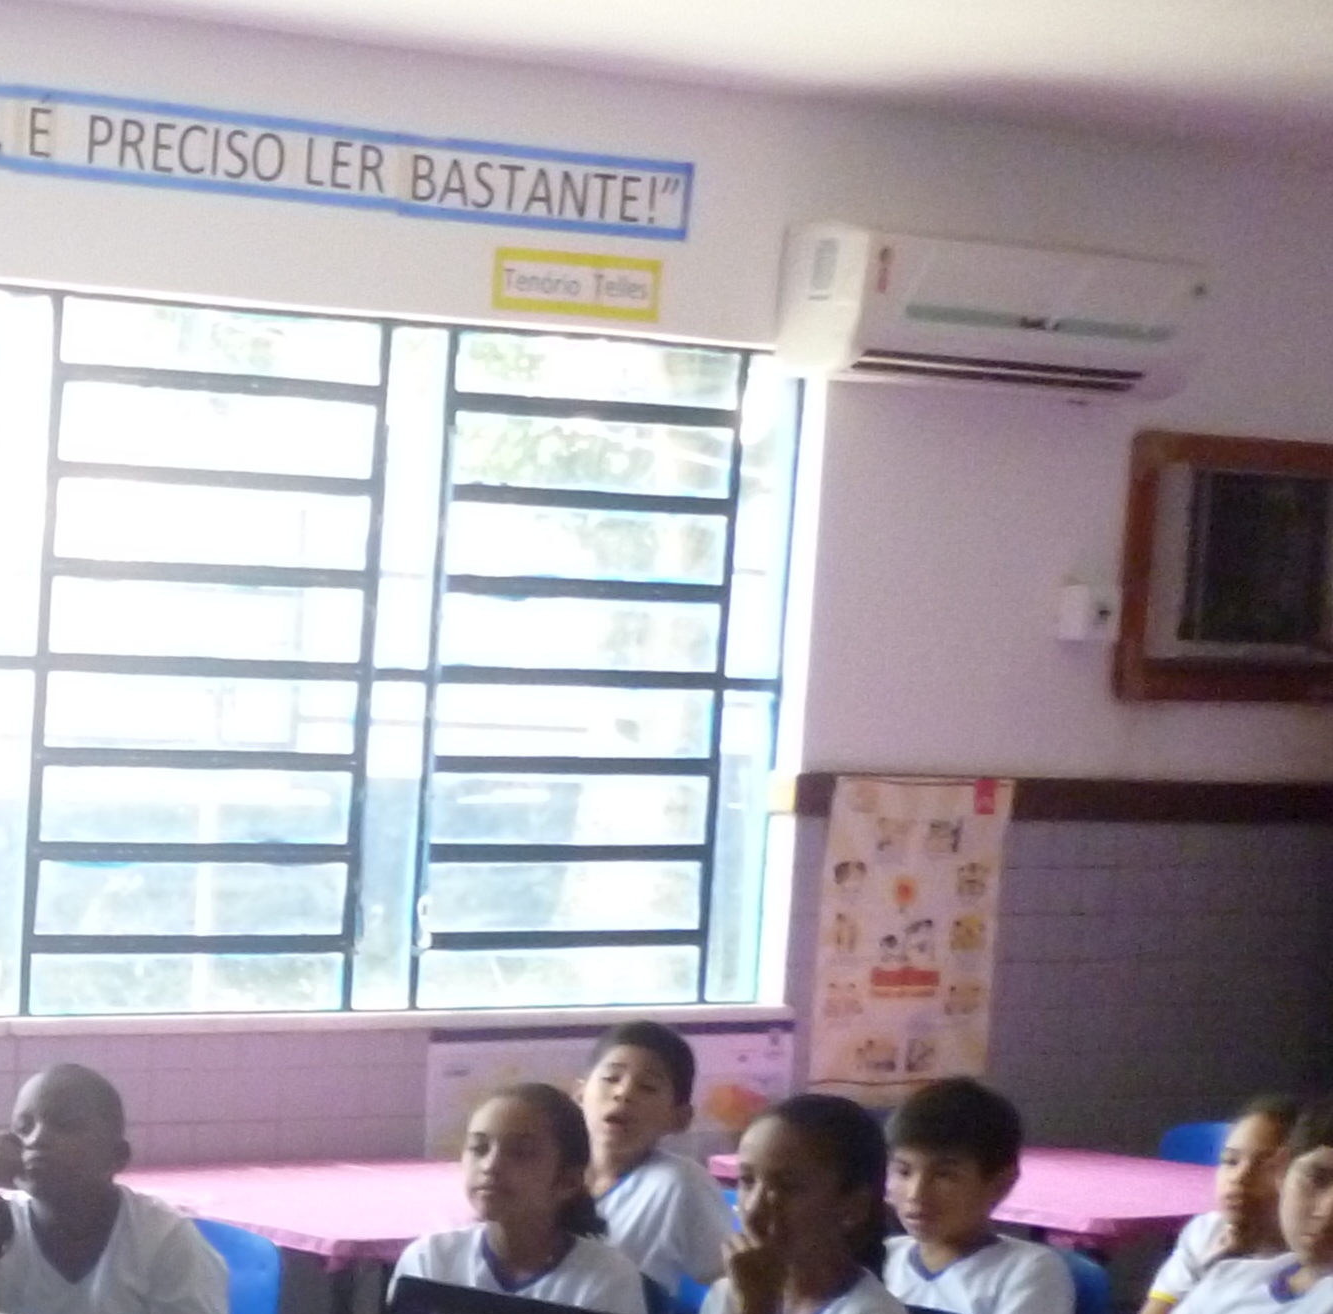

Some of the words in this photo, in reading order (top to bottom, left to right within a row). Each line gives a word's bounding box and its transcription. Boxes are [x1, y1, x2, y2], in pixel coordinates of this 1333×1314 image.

[27, 93, 54, 158] É
[86, 115, 287, 183] PRECISO
[305, 139, 385, 194] LER
